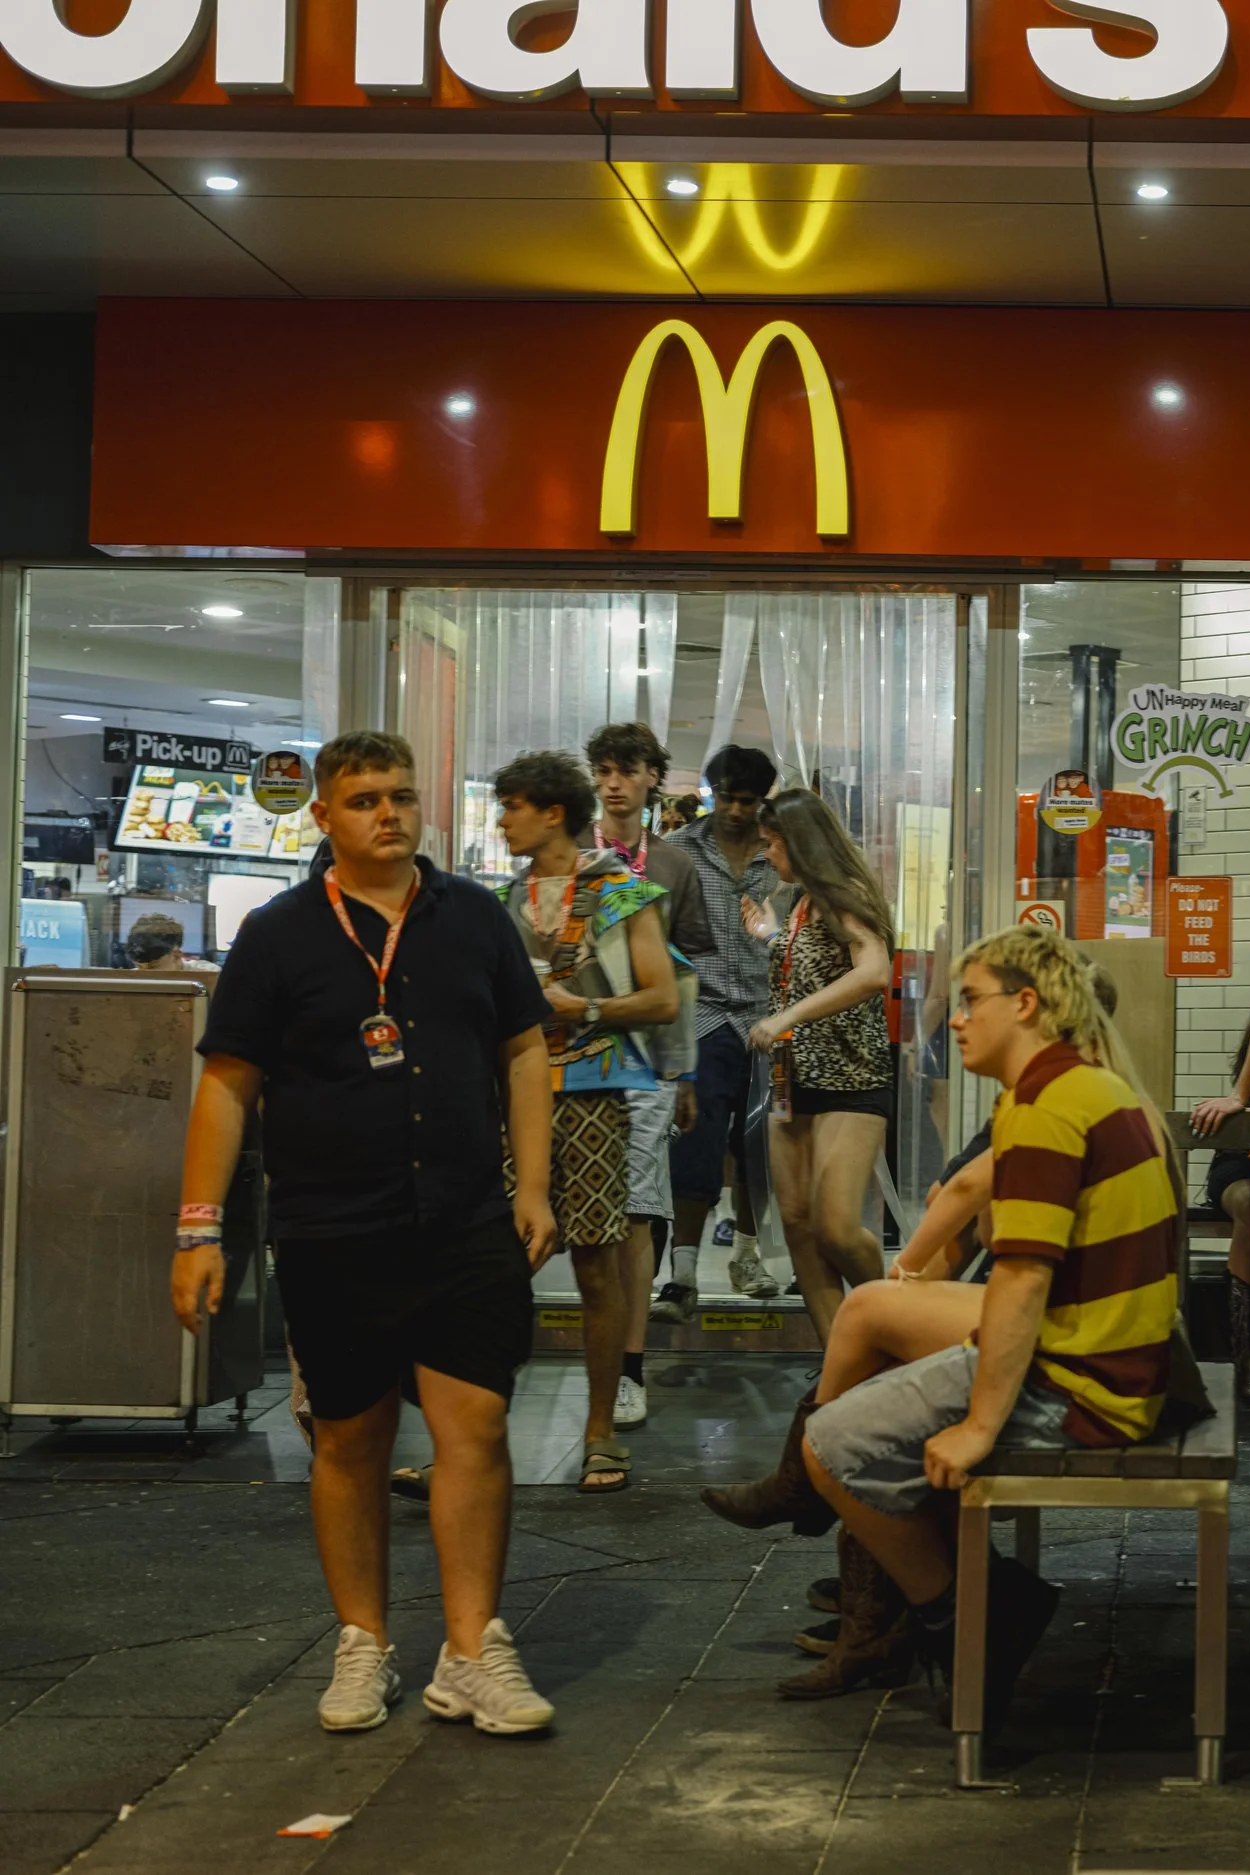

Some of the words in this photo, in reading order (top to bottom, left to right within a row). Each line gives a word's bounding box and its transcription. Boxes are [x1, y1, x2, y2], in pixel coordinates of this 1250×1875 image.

[135, 733, 222, 770] Pick-up
[1178, 899, 1195, 912] DO
[1197, 899, 1220, 912] NOT
[1184, 916, 1213, 929] FEED
[1187, 933, 1211, 946] THE
[1181, 950, 1217, 964] BIRDS
